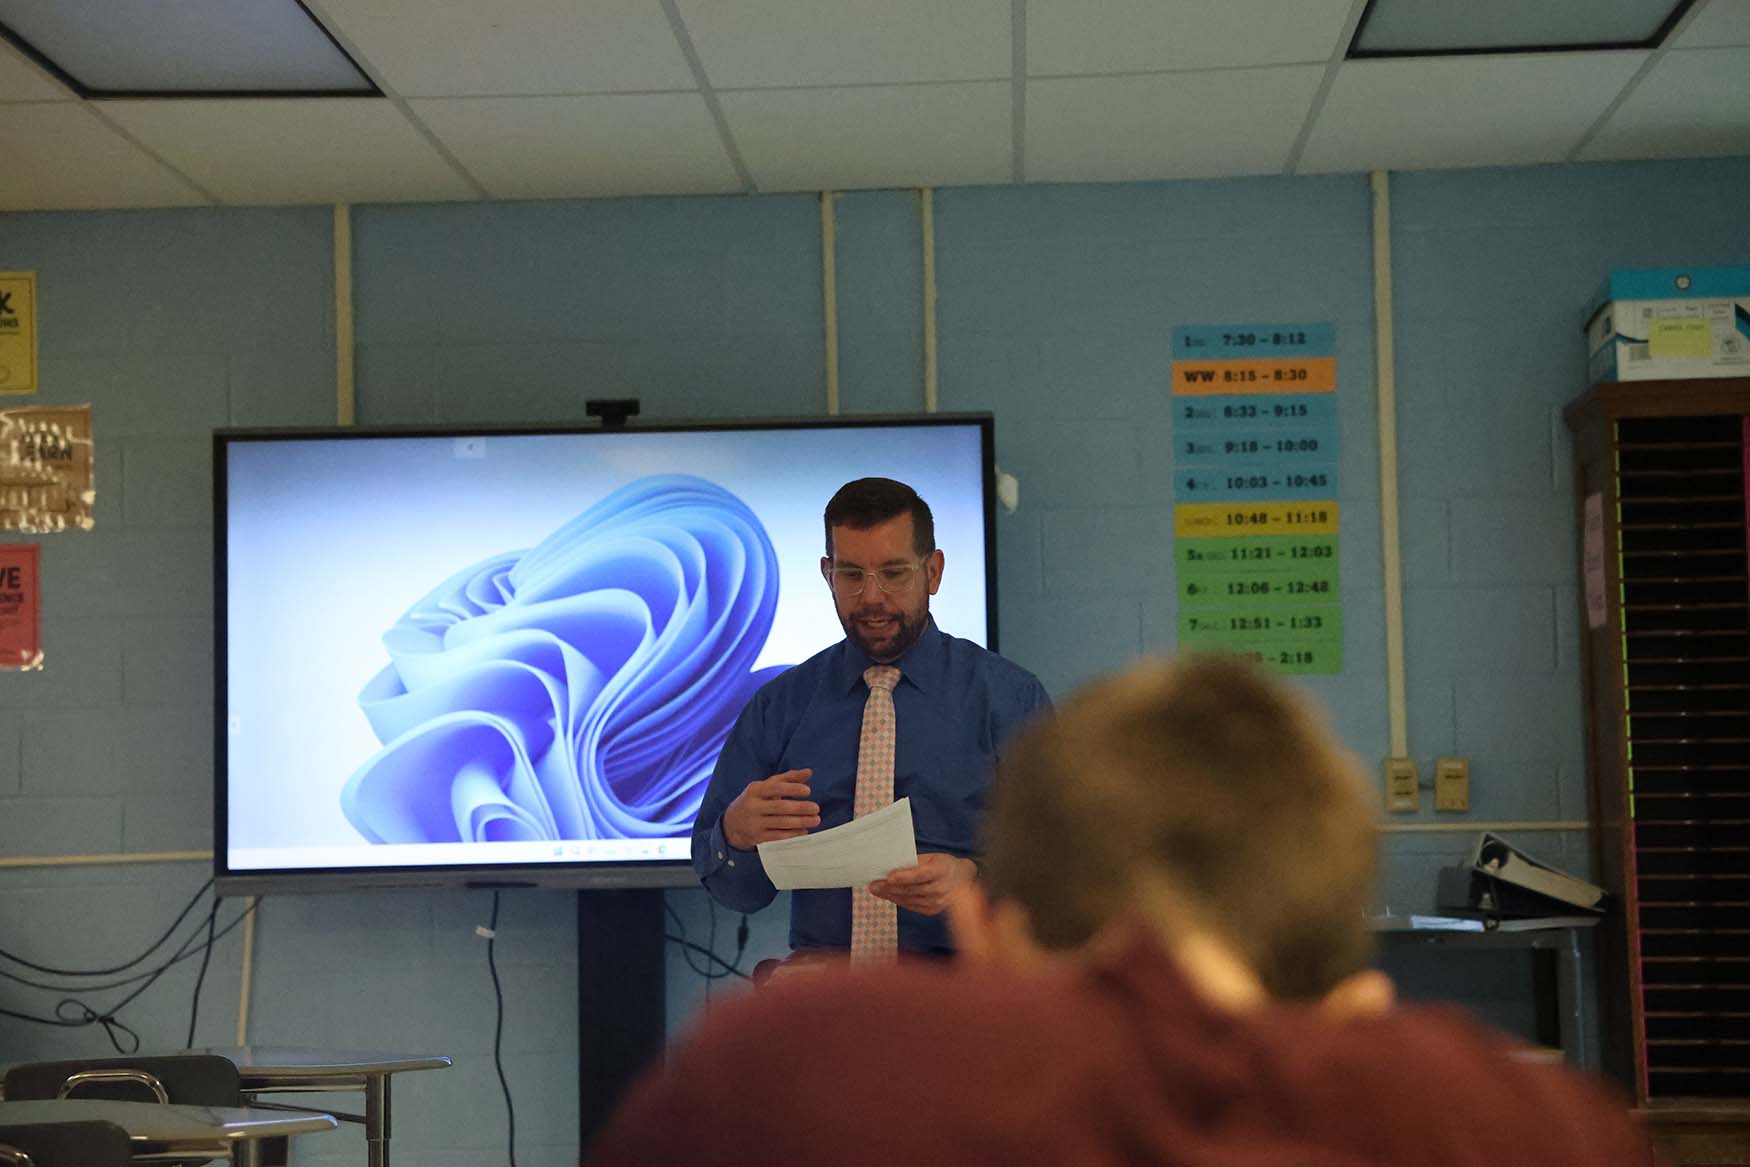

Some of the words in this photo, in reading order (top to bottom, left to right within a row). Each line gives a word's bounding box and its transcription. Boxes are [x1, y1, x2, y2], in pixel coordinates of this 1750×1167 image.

[1223, 333, 1256, 345] 7:30
[1272, 332, 1307, 345] 8:12
[1184, 370, 1216, 383] WW
[1224, 369, 1257, 382] 8:15
[1273, 368, 1307, 381] 8:30
[1224, 405, 1257, 418] 8:33
[1274, 404, 1308, 417] 9:15
[1225, 441, 1258, 454] 9:18
[1277, 439, 1319, 452] 10:00
[1227, 476, 1268, 489] 10:03
[1286, 474, 1328, 487] 10:45
[1227, 512, 1268, 525] 10:48
[1286, 511, 1328, 524] 11:18
[1231, 547, 1271, 560] 11:21
[1291, 545, 1333, 558] 12:03
[1228, 582, 1270, 595] 12:06
[1288, 581, 1329, 594] 12:48
[1230, 617, 1270, 630] 12:51
[1290, 616, 1323, 629] 1:33
[1280, 651, 1313, 664] 2:18
